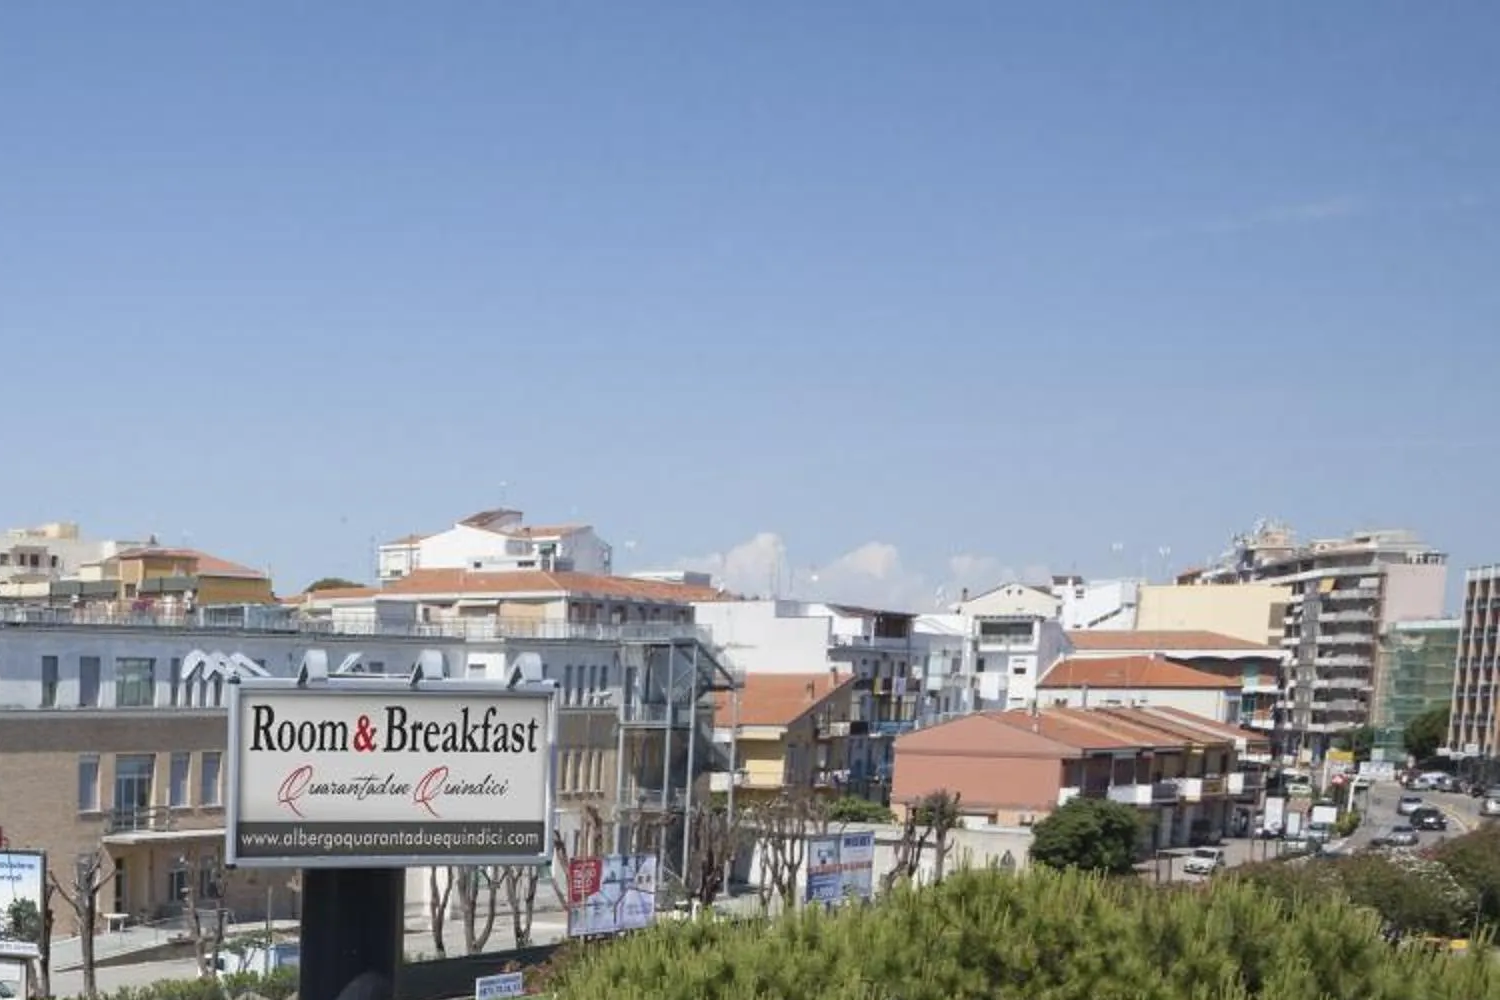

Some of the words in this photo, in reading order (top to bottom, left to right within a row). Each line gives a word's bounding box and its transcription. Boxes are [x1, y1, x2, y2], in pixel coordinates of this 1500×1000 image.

[250, 705, 348, 752] Room
[353, 713, 377, 752] &
[383, 705, 539, 753] Breakfast
[277, 765, 410, 818] Quarantadue
[412, 765, 509, 818] Quindici
[240, 827, 540, 850] www.albergoquarantaduequindici.com
